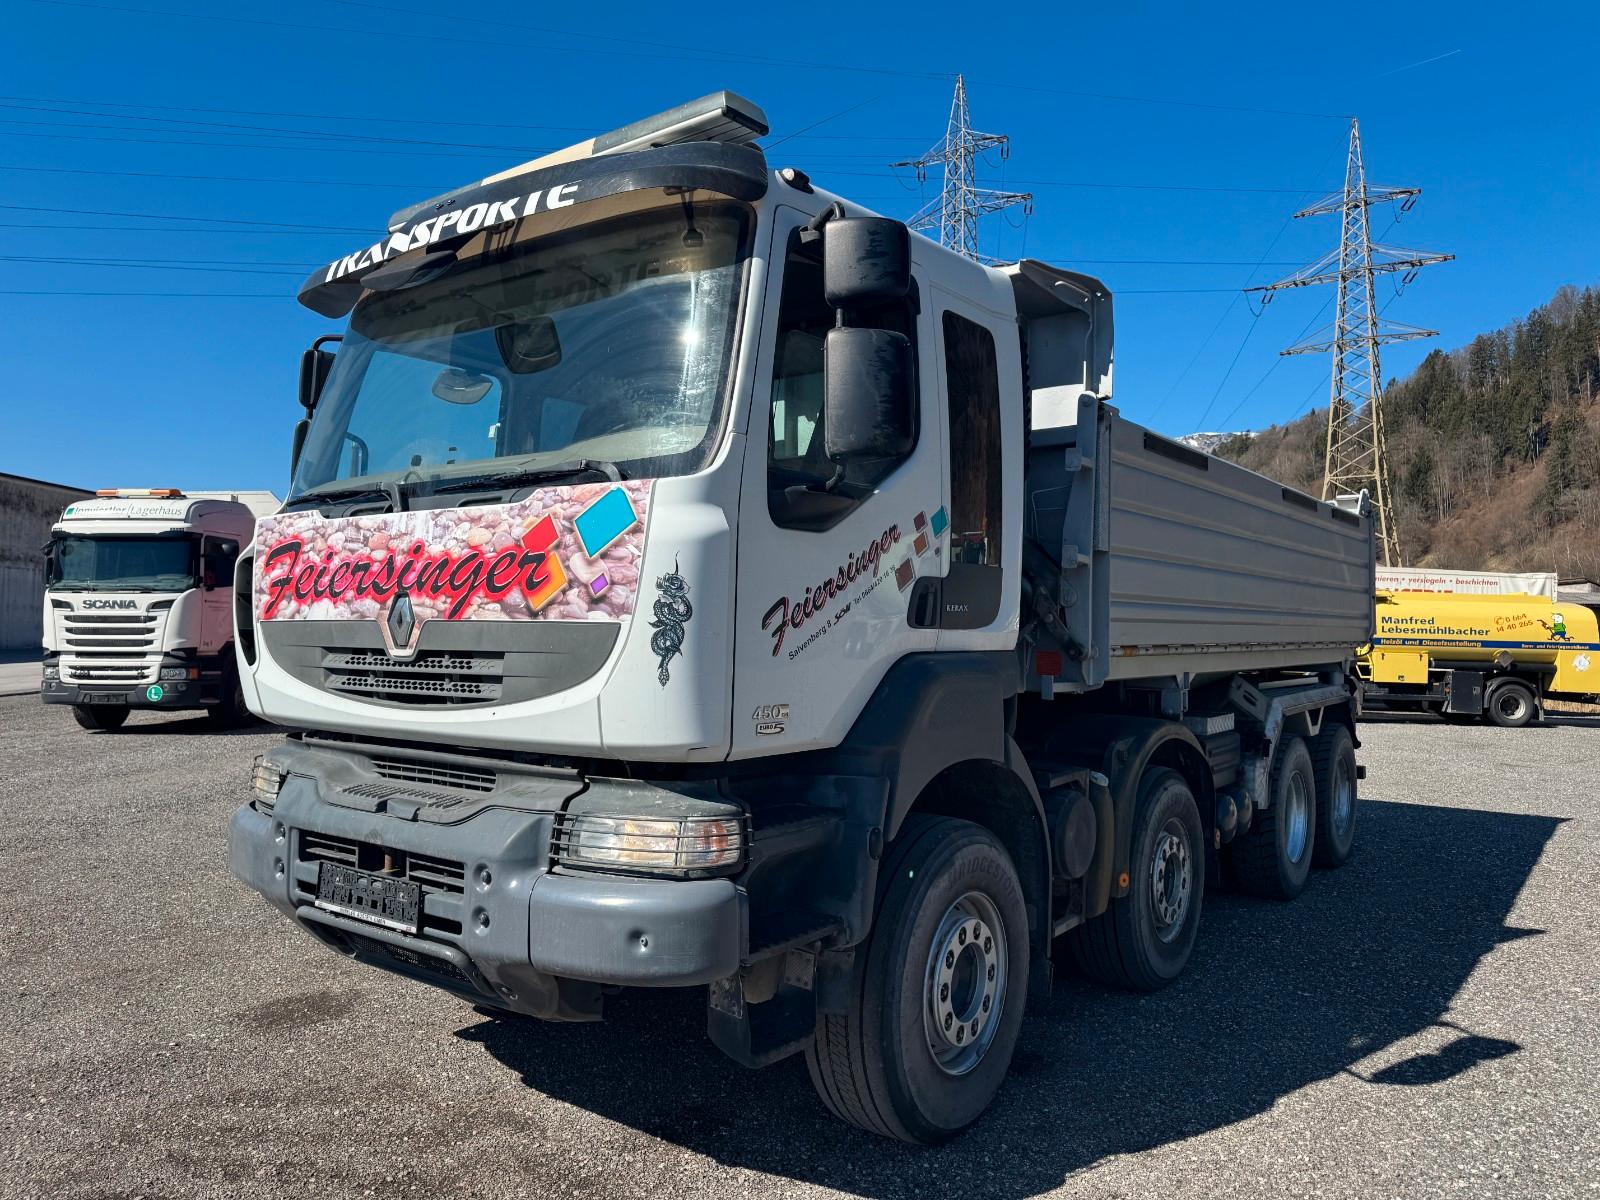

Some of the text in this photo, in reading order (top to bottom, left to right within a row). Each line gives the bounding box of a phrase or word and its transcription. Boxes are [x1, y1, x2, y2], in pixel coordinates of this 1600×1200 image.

[324, 181, 584, 283] TRANSPORTE
[130, 504, 183, 516] Lagerhaus
[263, 538, 552, 620] Feiersinger
[1455, 577, 1499, 586] beschichten
[761, 522, 902, 657] Feiersinger
[82, 599, 138, 610] SCANIA
[1381, 616, 1435, 625] Manfred
[1381, 625, 1491, 636] Lebesmühlbacher
[788, 625, 827, 661] Salvenberg
[751, 704, 781, 721] 450
